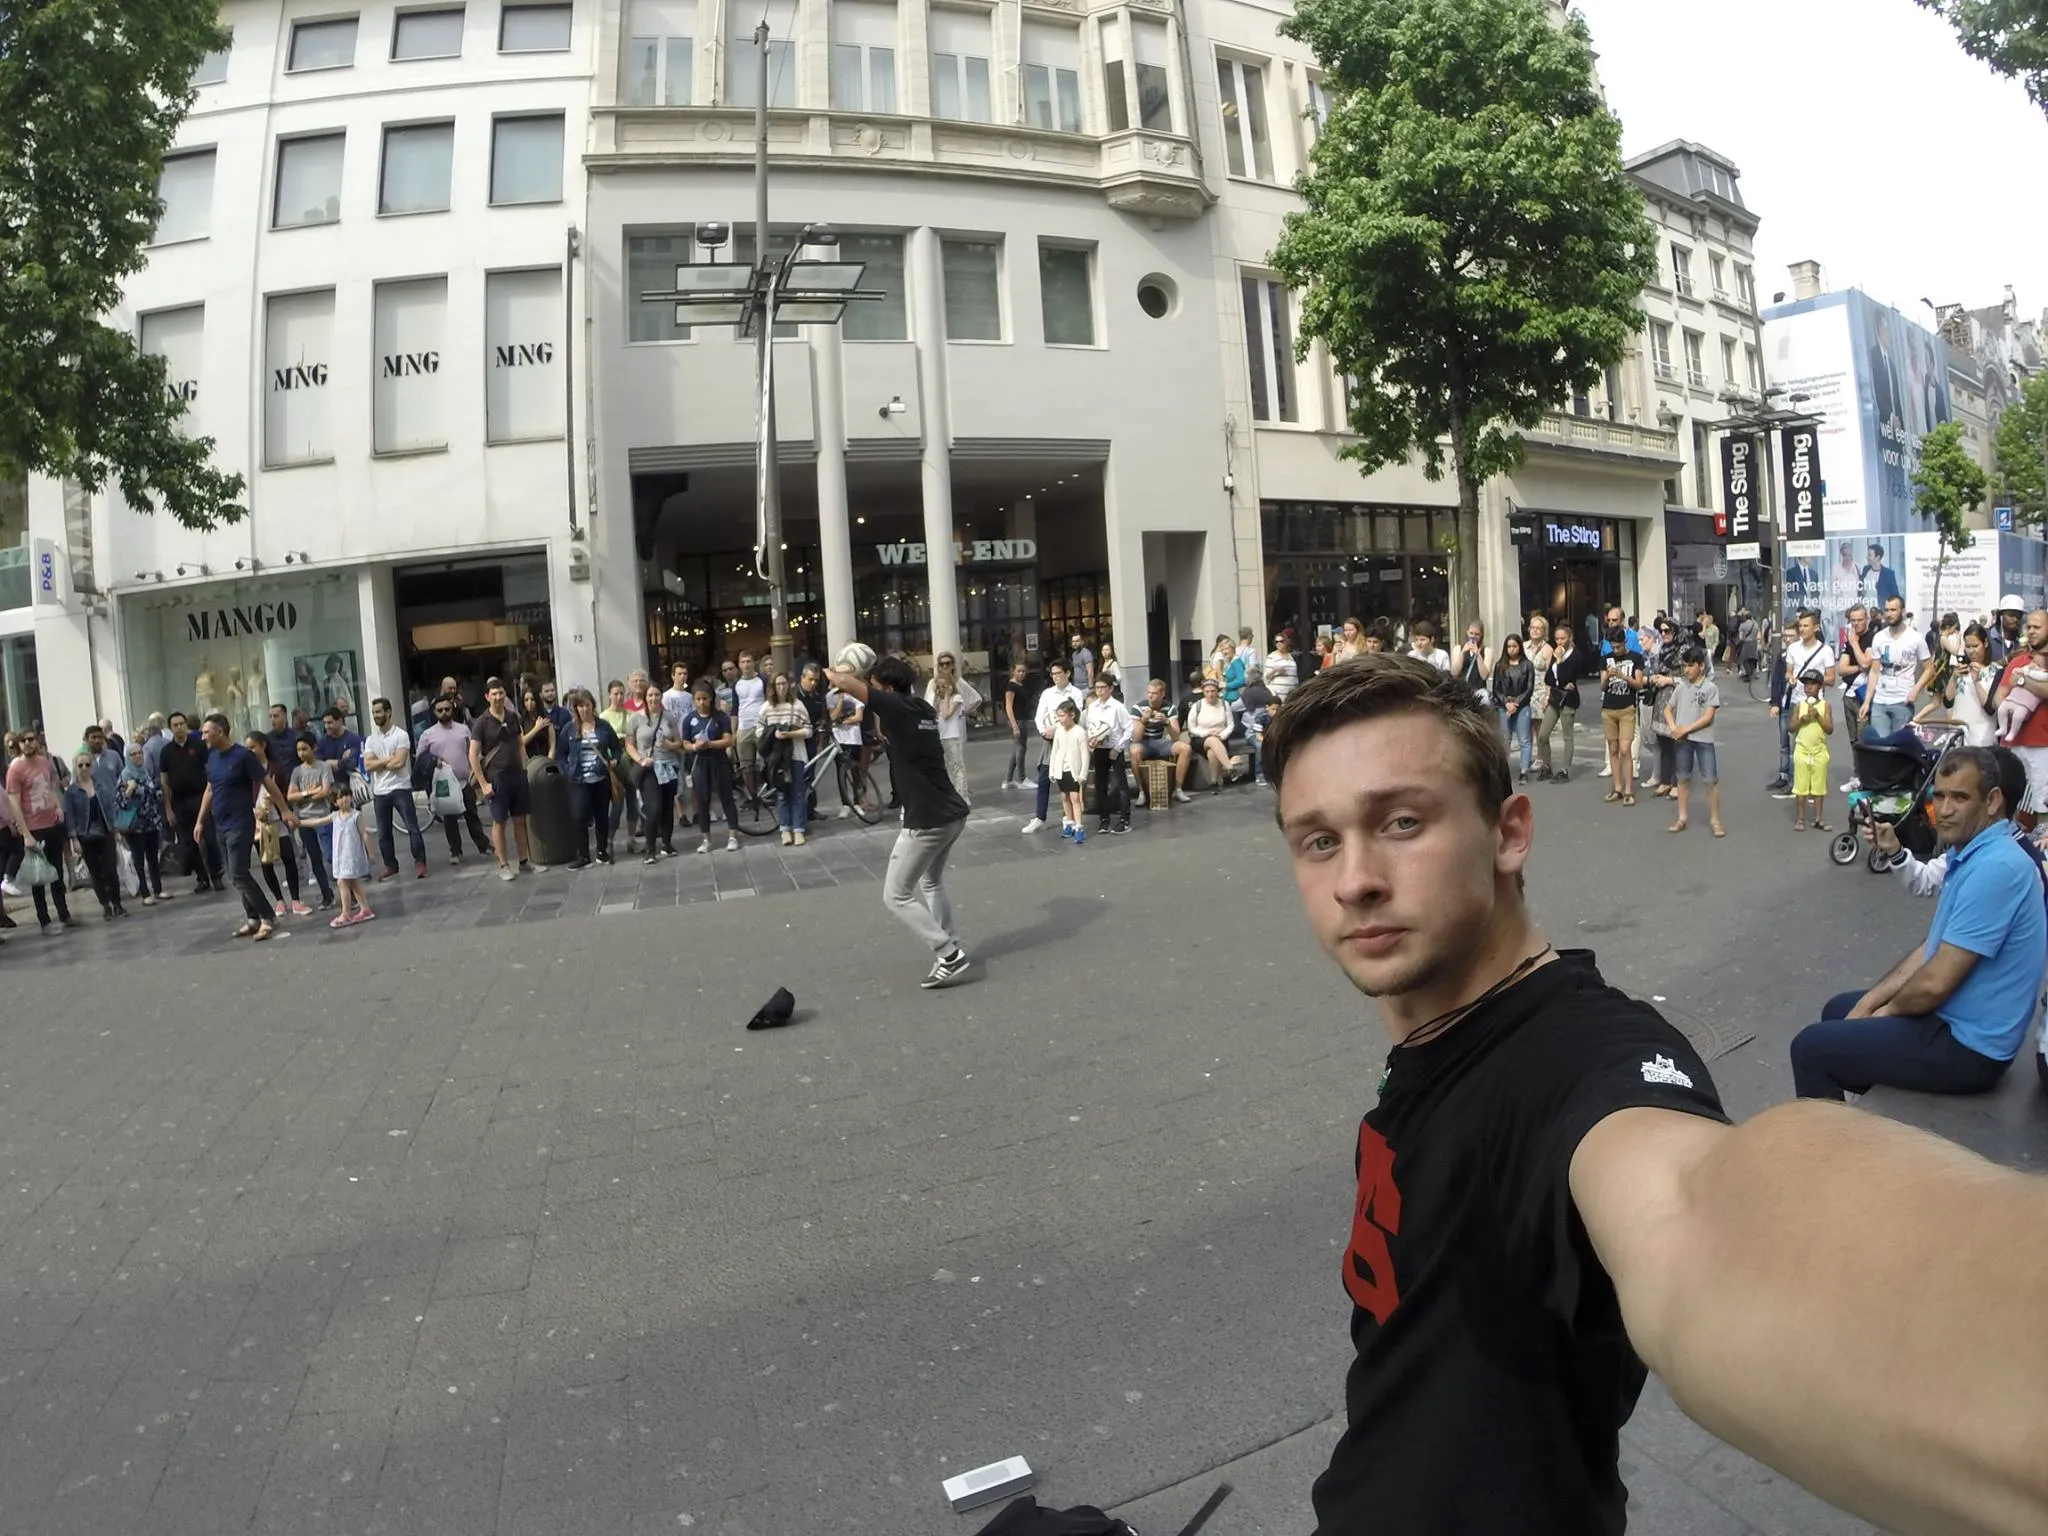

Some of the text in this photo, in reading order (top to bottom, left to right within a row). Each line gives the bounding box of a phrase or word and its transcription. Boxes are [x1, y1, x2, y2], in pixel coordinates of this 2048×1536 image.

[383, 351, 440, 378] MNG
[495, 342, 553, 368] MNG
[166, 380, 198, 401] NG
[273, 362, 328, 392] MNG
[1730, 442, 1749, 494] Sting
[1791, 433, 1812, 489] Sting
[1733, 496, 1749, 537] The
[1794, 490, 1813, 533] The
[1546, 523, 1600, 549] The Sting
[876, 540, 1037, 565] WE-END
[42, 553, 52, 591] P&B
[1785, 579, 1877, 596] een vast gezicht
[1784, 594, 1878, 610] uw beleggingen
[187, 601, 297, 641] MANGO
[574, 634, 583, 643] 73
